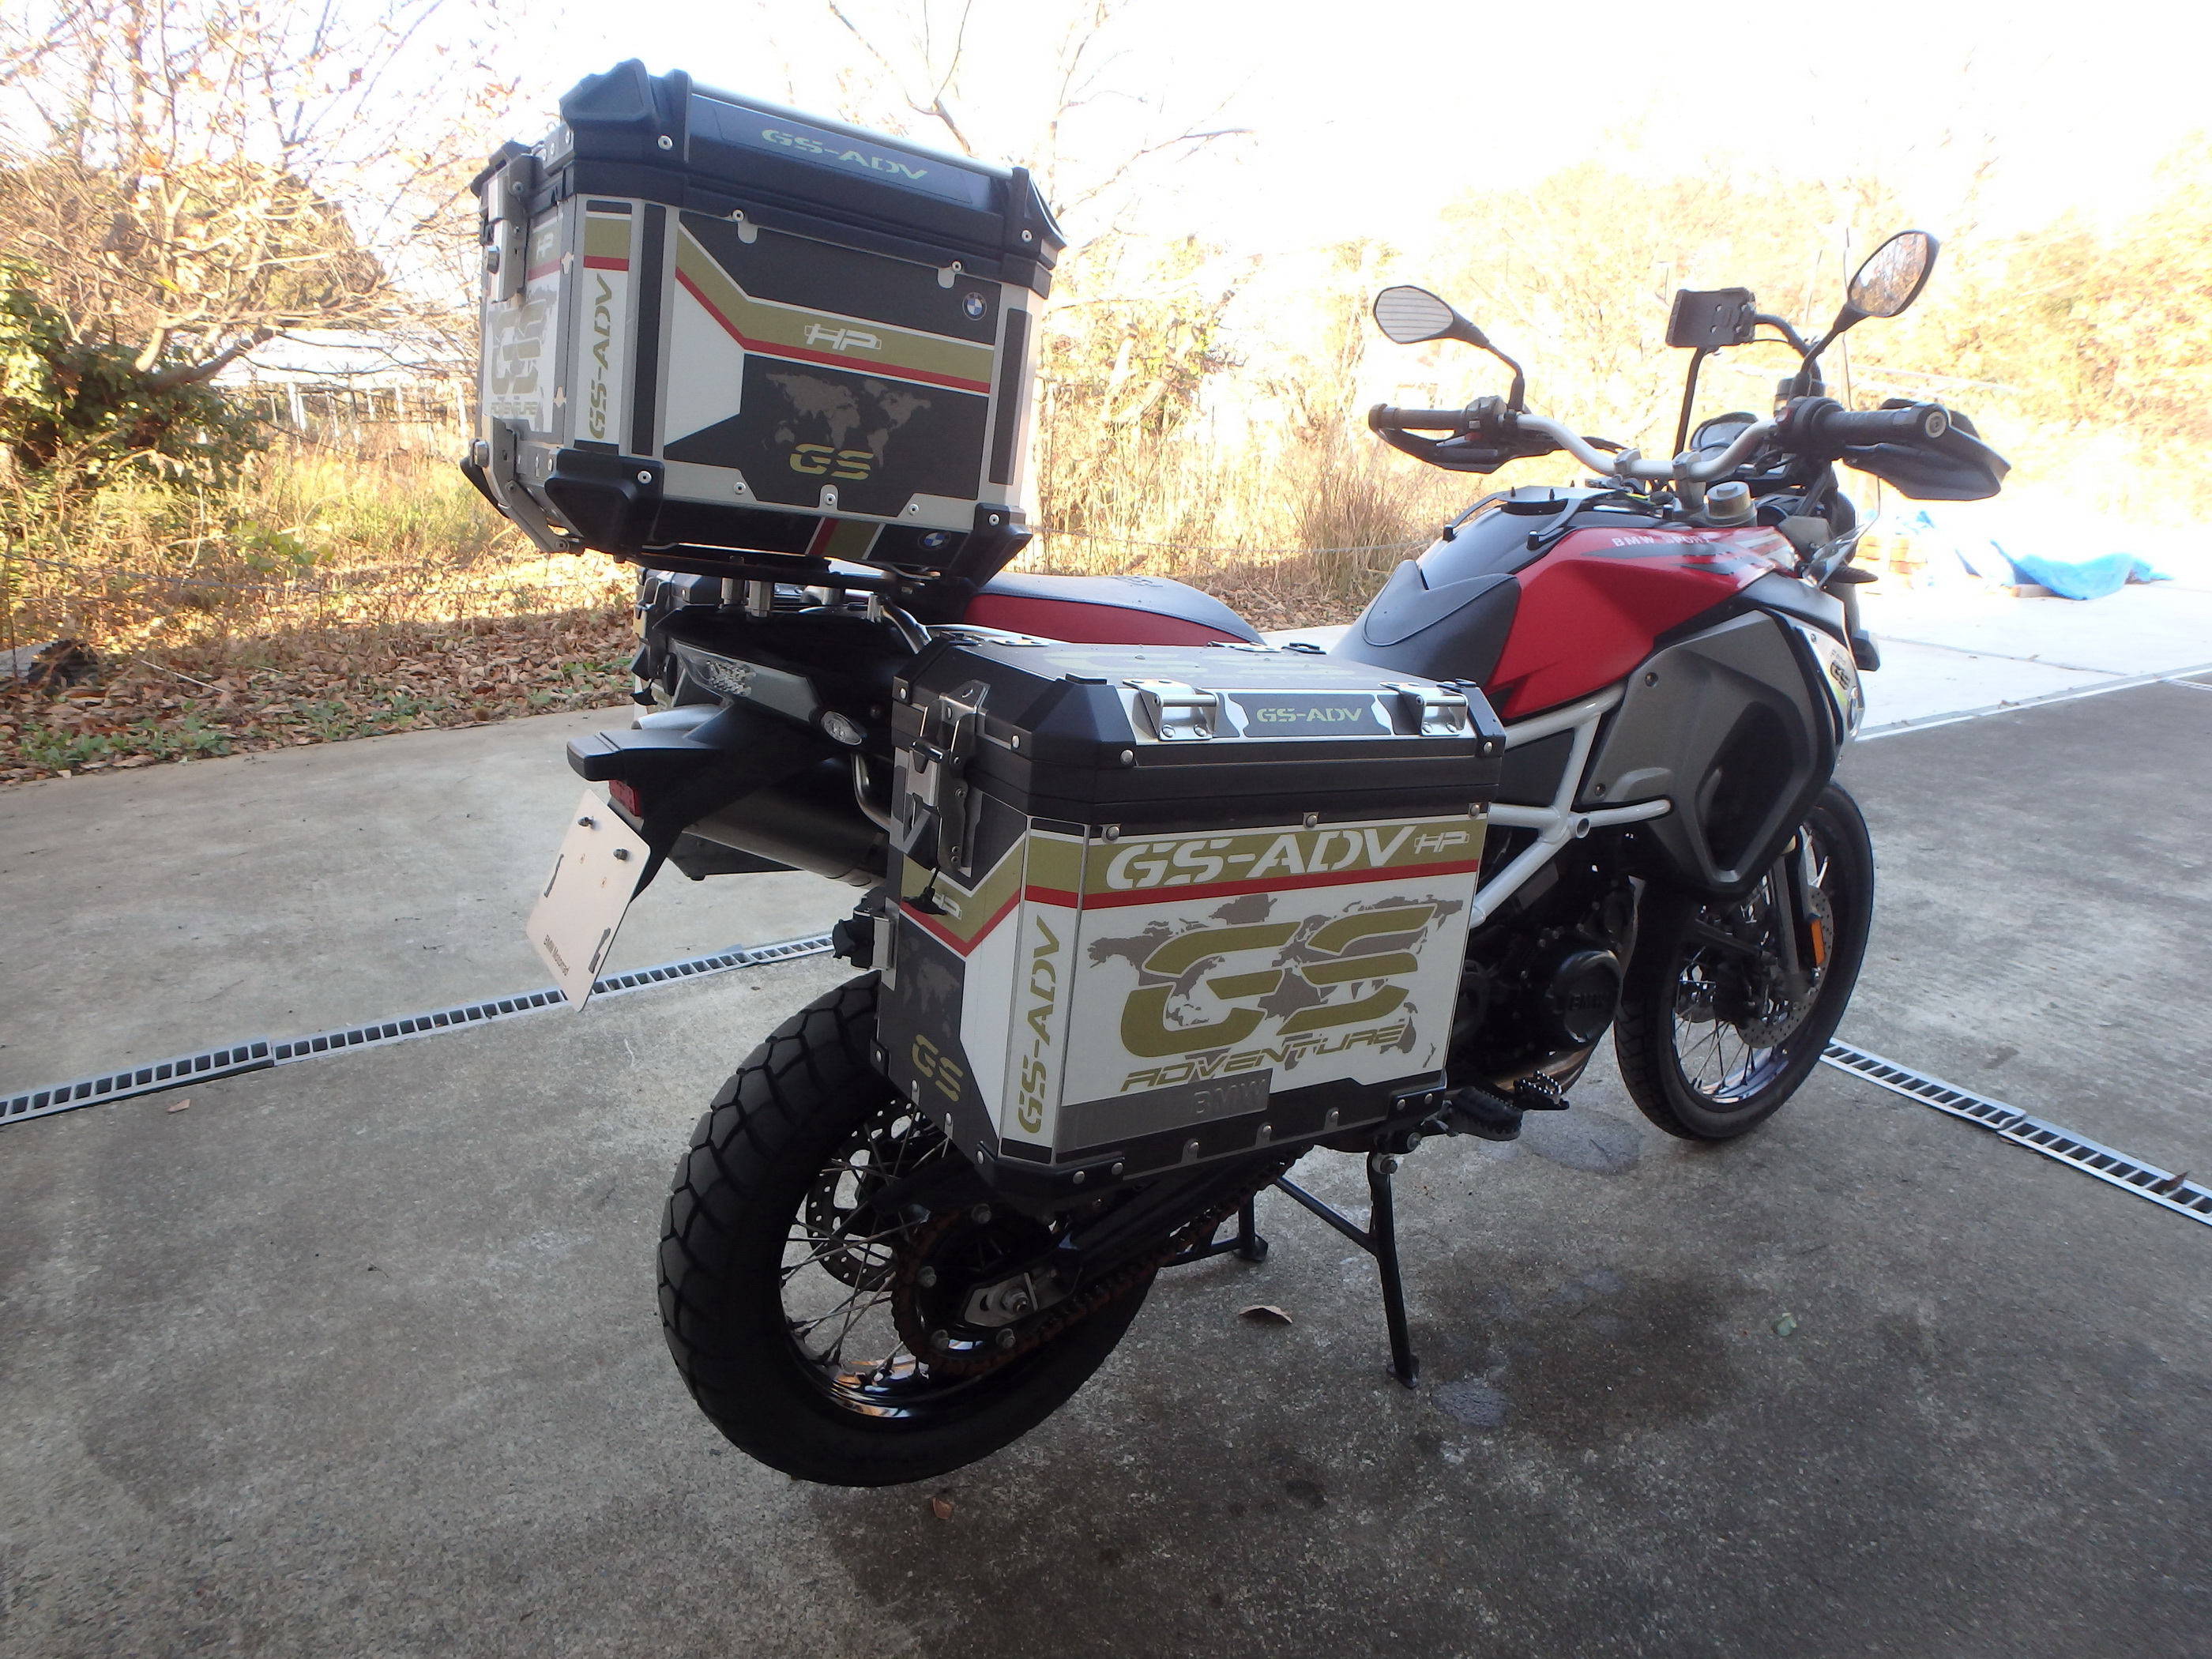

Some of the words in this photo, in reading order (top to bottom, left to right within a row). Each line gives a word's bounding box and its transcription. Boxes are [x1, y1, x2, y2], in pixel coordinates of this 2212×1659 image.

[762, 129, 928, 180] GS-ADV
[589, 273, 612, 439] GS-ADV
[804, 322, 882, 352] HP
[789, 442, 875, 480] GS
[1611, 535, 1655, 547] BMW
[1661, 534, 1711, 544] SPORT
[1256, 708, 1362, 722] GS-ADV
[1105, 825, 1418, 890] GS-ADV
[1018, 914, 1060, 1134] GS-ADV
[912, 1034, 963, 1102] GS
[1119, 1024, 1405, 1093] ADVENTURE
